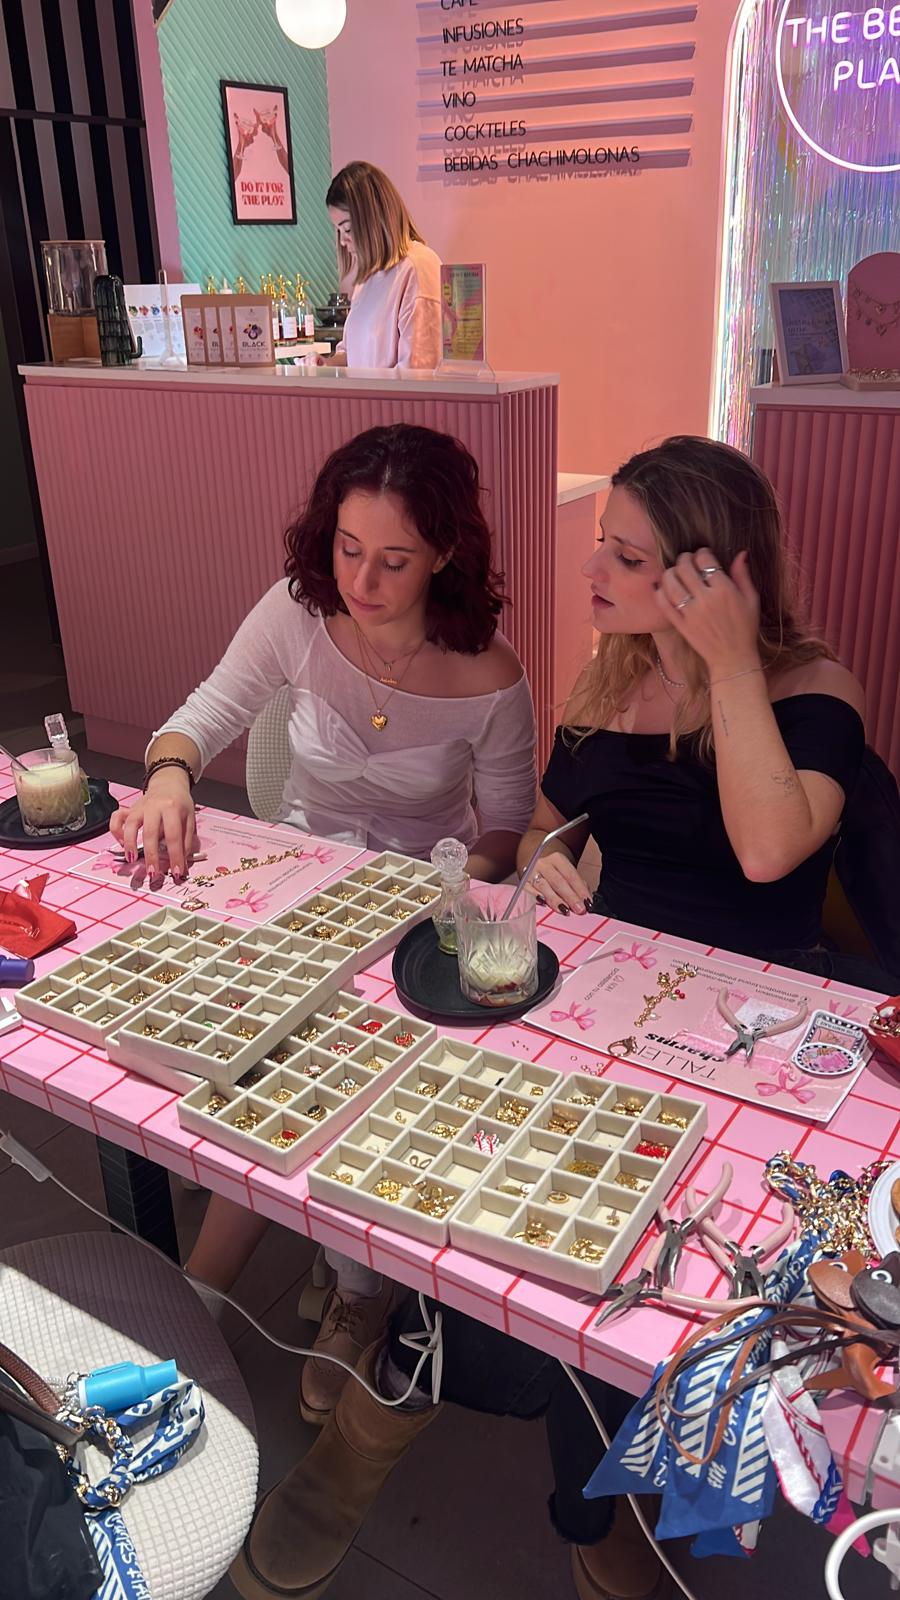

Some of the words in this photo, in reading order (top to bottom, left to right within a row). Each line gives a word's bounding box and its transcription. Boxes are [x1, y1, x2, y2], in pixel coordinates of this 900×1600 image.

[442, 18, 524, 44] INFUSIONES
[784, 11, 852, 48] THE
[440, 60, 457, 77] TE
[463, 54, 524, 73] MATCHA
[442, 91, 476, 109] VINO
[444, 120, 527, 142] COCKTELES
[444, 154, 498, 173] BEBIDAS
[507, 146, 641, 169] CHACHIMOLONAS
[240, 181, 254, 193] DO
[255, 181, 265, 193] IT
[266, 181, 284, 193] FOR
[242, 195, 260, 206] THE
[261, 195, 285, 206] PLOT
